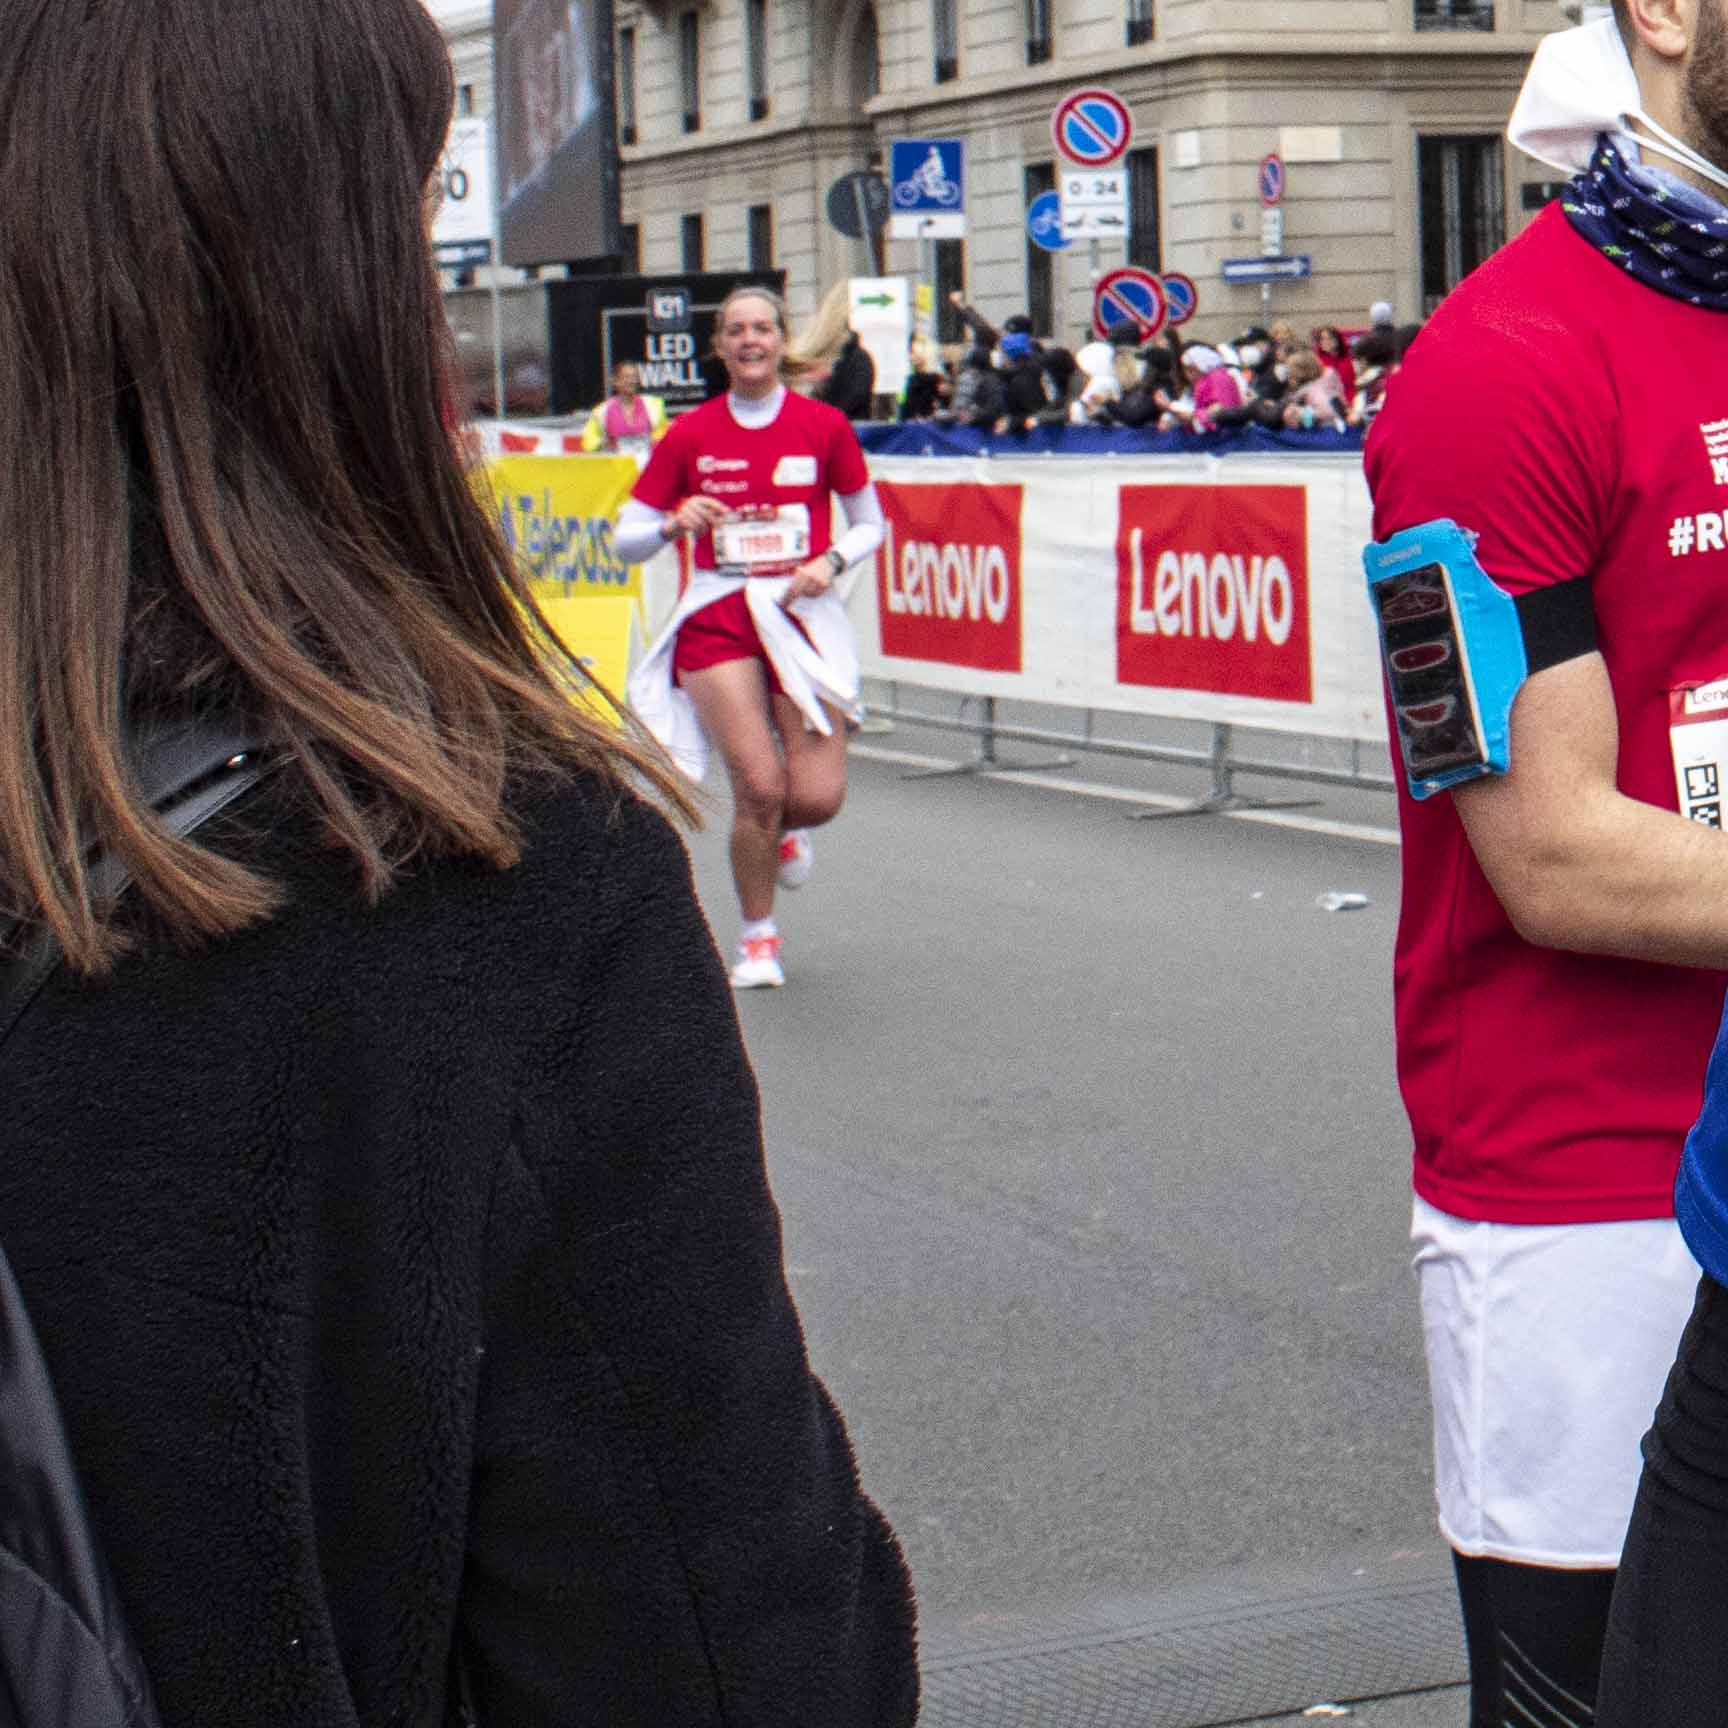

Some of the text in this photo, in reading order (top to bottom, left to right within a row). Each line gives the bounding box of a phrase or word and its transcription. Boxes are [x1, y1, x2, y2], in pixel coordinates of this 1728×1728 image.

[638, 360, 706, 388] WALL
[645, 333, 695, 361] LED
[882, 518, 1009, 625] Lenovo
[1130, 526, 1294, 647] Lenovo
